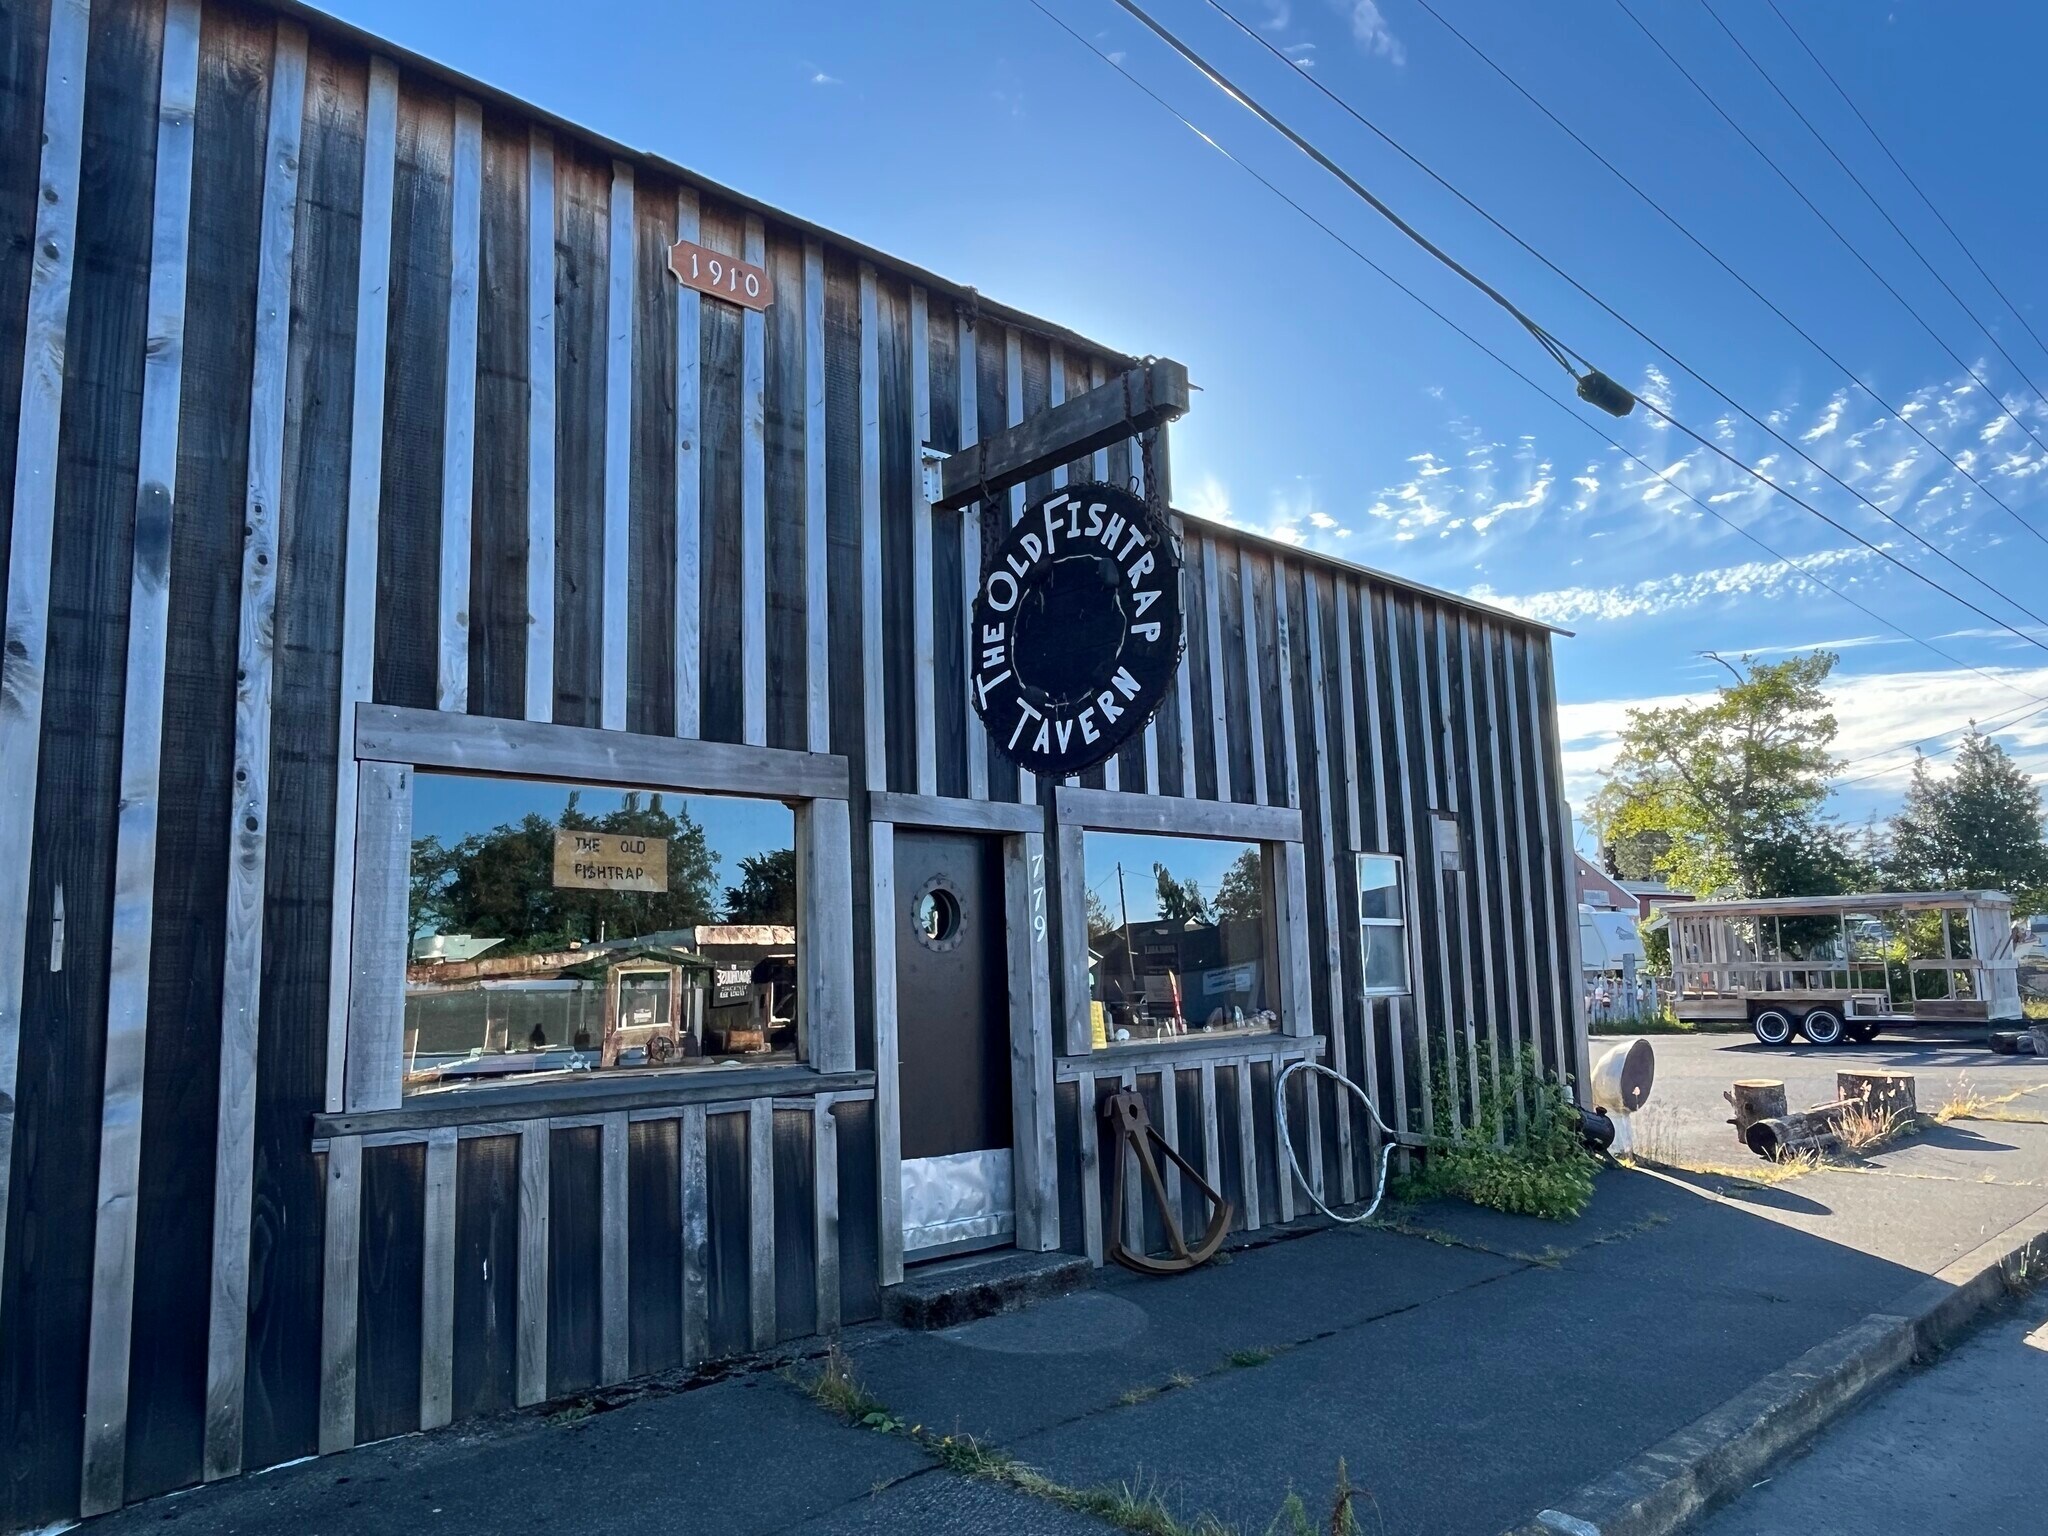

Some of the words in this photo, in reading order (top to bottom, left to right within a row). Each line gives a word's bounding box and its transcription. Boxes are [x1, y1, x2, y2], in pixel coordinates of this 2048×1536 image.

[692, 253, 759, 297] 1910
[987, 533, 1042, 612] OLD
[1043, 494, 1162, 642] FISHTRAP
[976, 622, 1012, 710] THE
[1008, 666, 1141, 754] TAVERN
[575, 837, 600, 853] THE
[620, 840, 646, 854] OLD
[575, 863, 644, 880] FISHTRAP
[1031, 853, 1046, 943] 779
